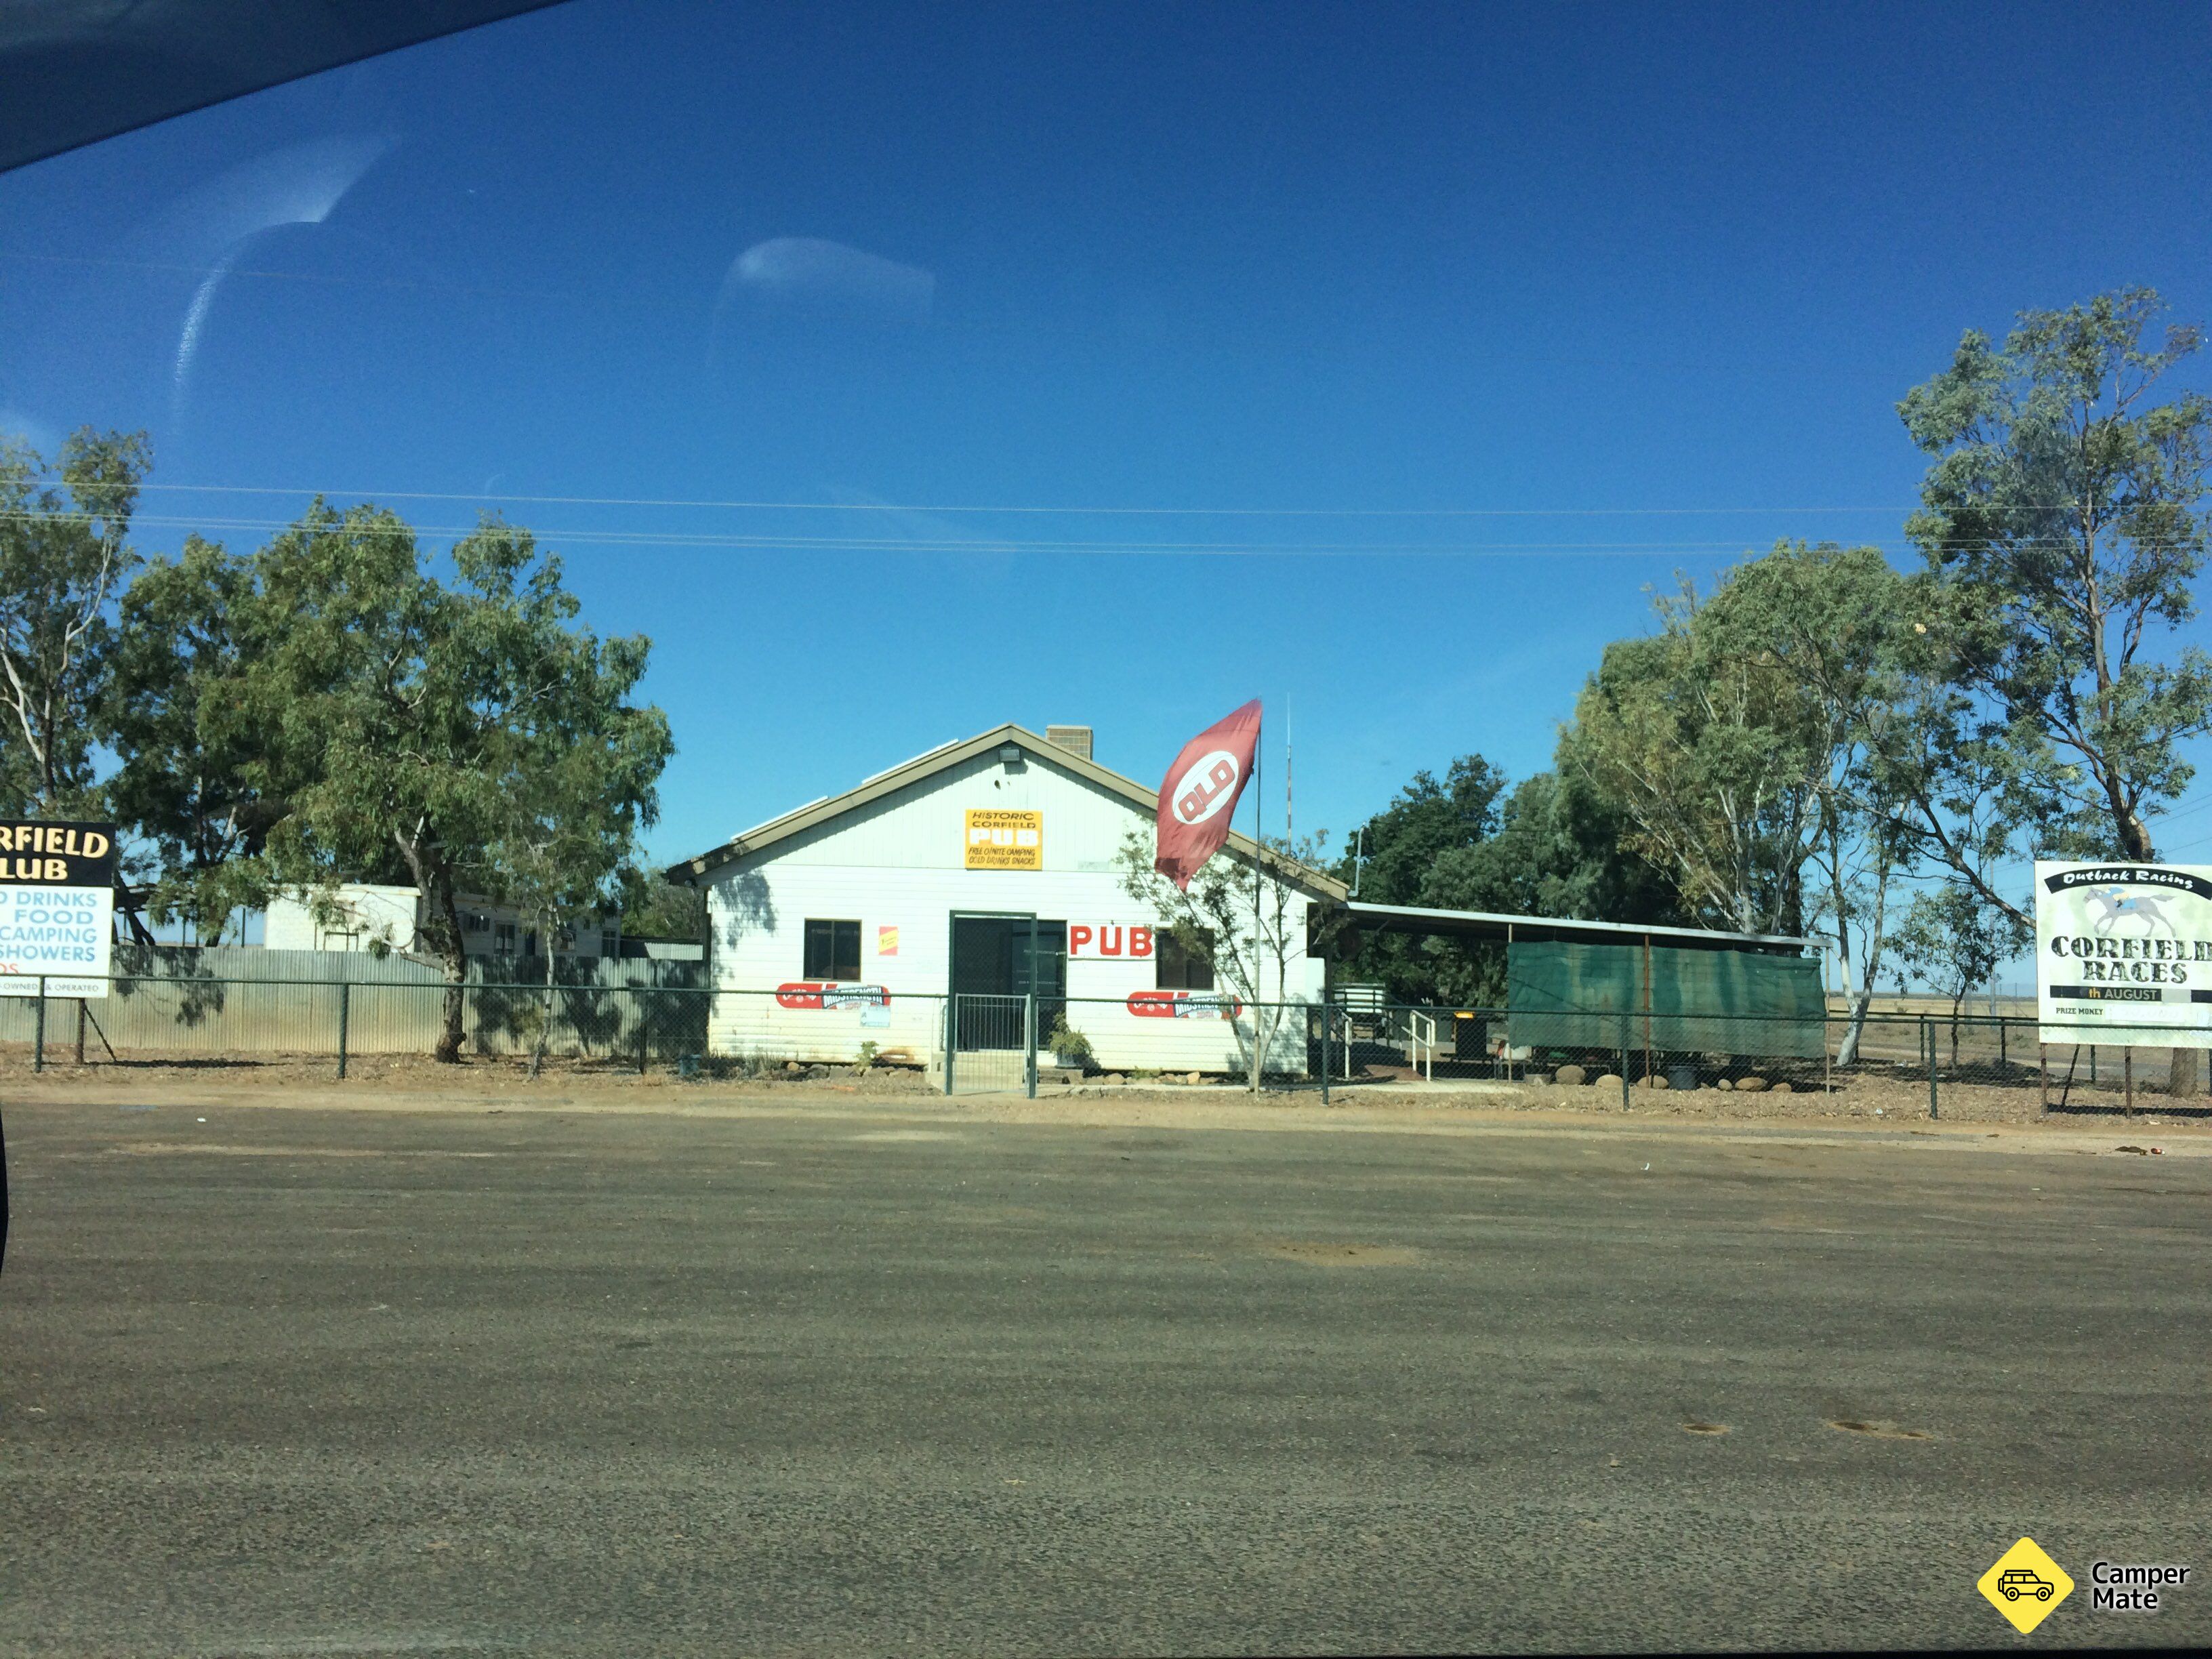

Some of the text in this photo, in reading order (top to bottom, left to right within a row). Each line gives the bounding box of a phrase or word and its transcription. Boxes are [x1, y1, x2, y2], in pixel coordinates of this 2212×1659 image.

[1179, 760, 1235, 821] QLD
[972, 812, 1034, 820] HISTORIC
[0, 825, 109, 859] RFIELD
[969, 829, 1038, 846] PUB
[986, 856, 1010, 865] DRINKS
[1012, 857, 1036, 865] SNACKS
[1006, 848, 1035, 857] CAMPING
[0, 858, 67, 880] LUB
[2063, 870, 2193, 889] Outback Racing
[16, 891, 97, 907] DRINKS
[14, 909, 94, 924] FOOD
[0, 926, 97, 943] CAMPING
[1071, 926, 1153, 956] PUB
[2051, 936, 2212, 962] CORFIELD
[2083, 960, 2188, 983] RACES
[2089, 987, 2156, 1000] th AUGUST
[1175, 997, 1235, 1016] MIDSTREN
